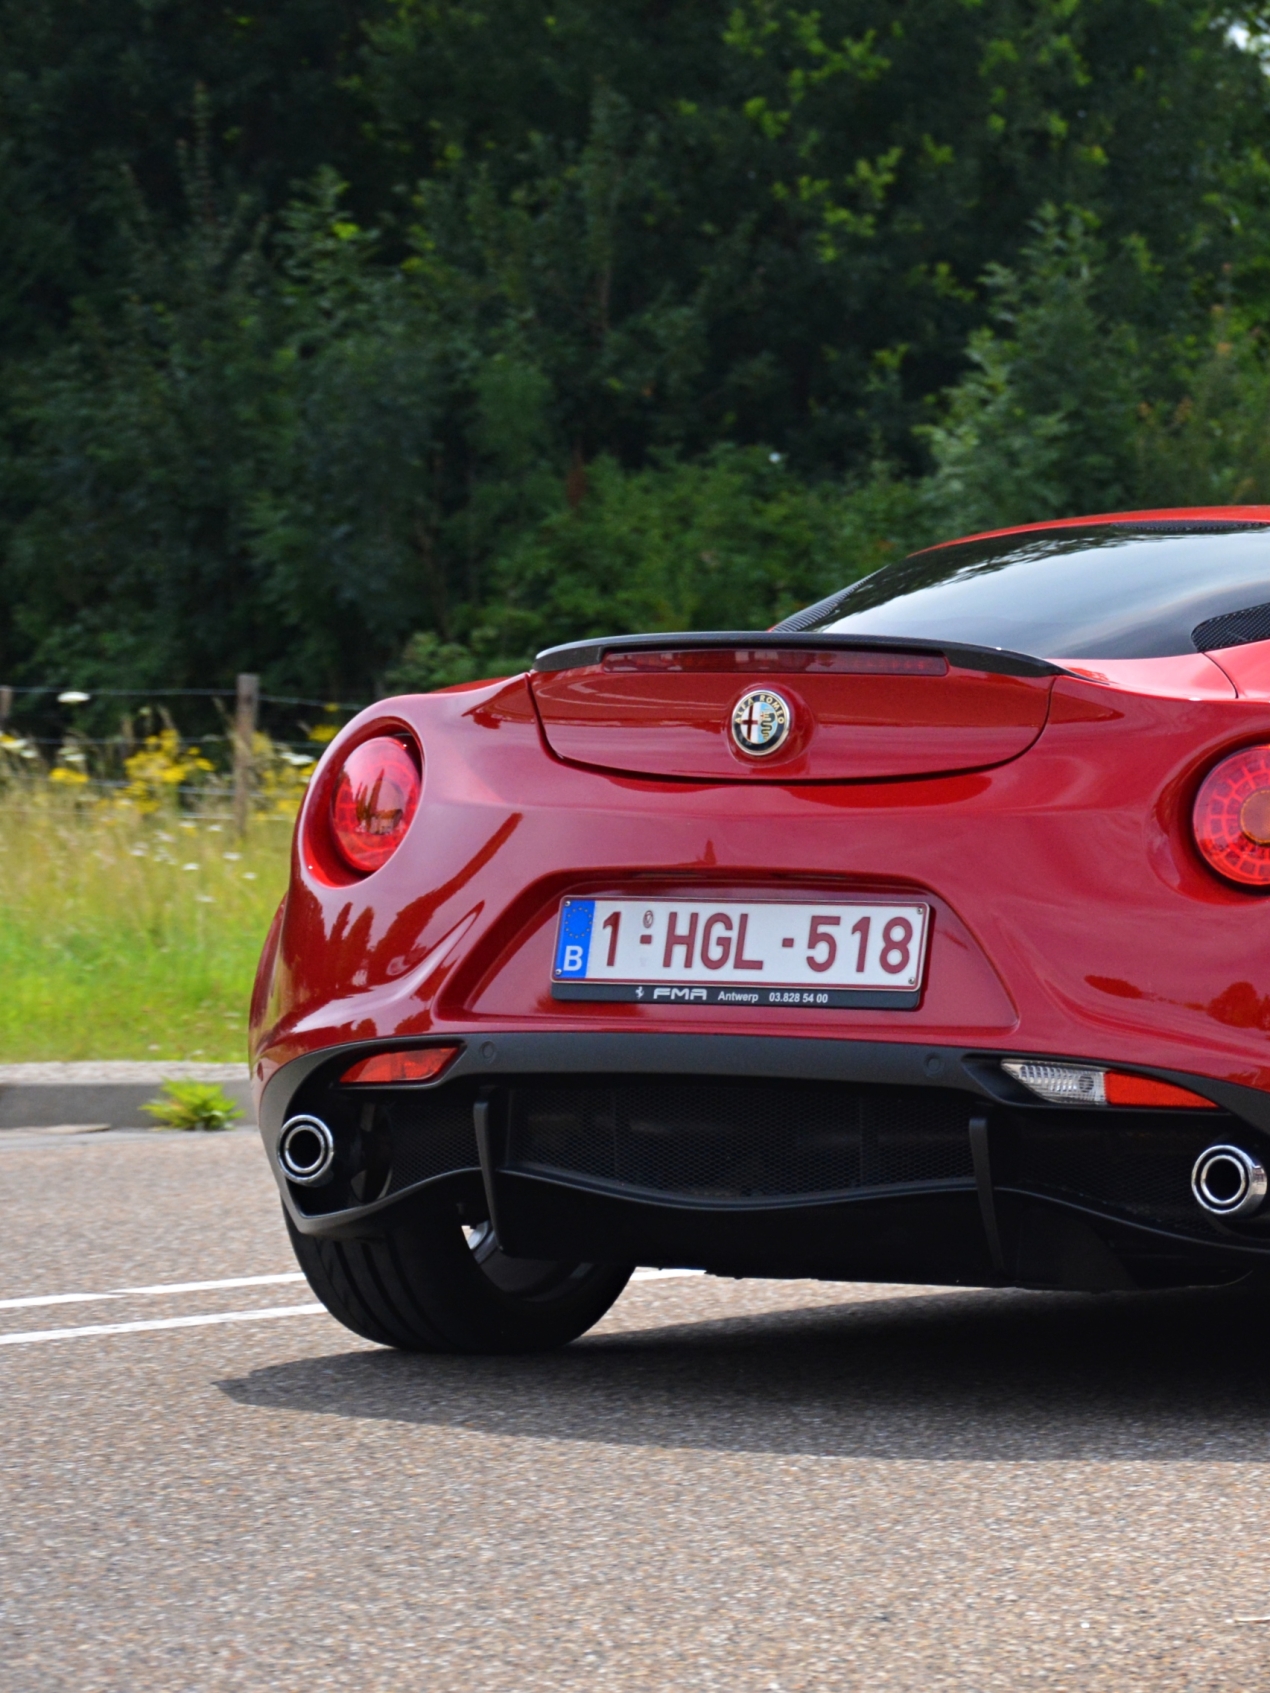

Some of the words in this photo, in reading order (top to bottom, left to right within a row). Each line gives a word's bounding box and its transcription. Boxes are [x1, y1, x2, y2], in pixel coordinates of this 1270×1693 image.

[735, 698, 754, 724] ALFA
[760, 695, 785, 724] ROMEO
[563, 944, 583, 972] B
[653, 988, 708, 1000] FMA
[718, 990, 759, 1005] Antwerp
[769, 991, 801, 1004] 03.828
[802, 992, 814, 1004] 54
[816, 992, 829, 1005] 00
